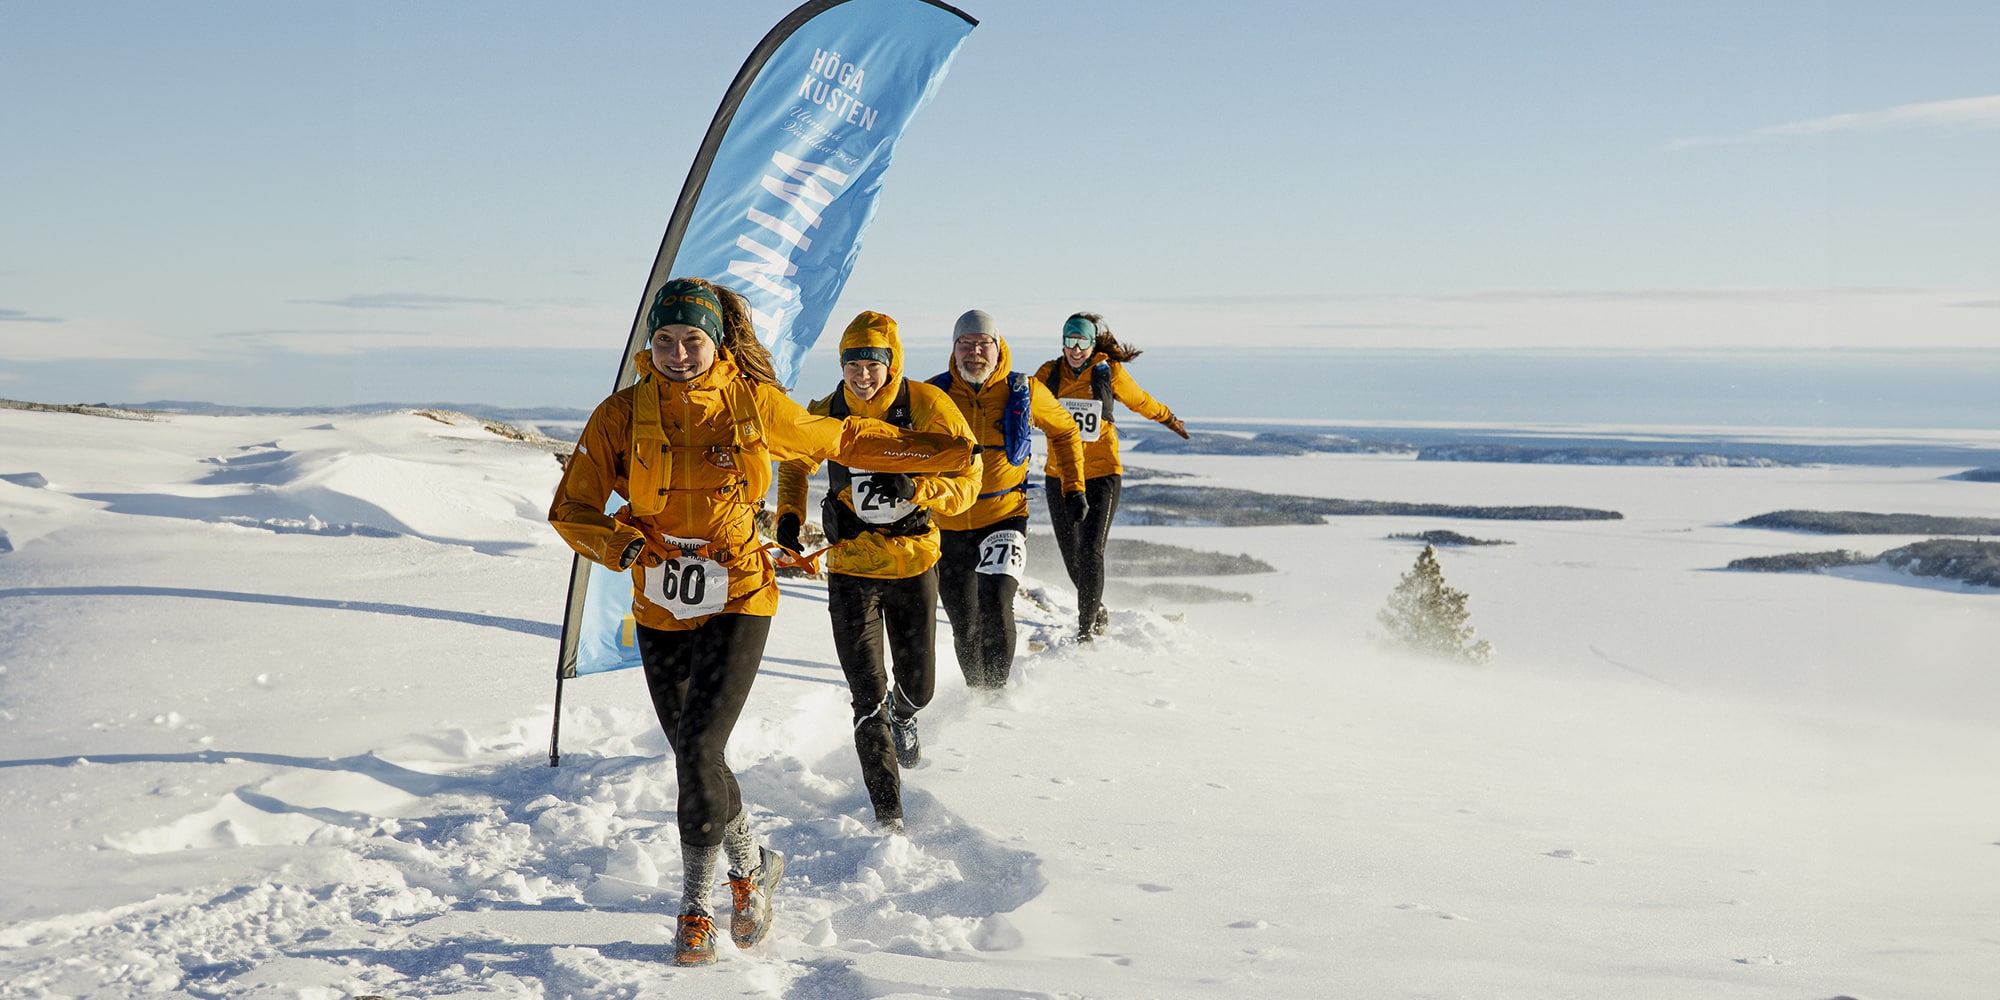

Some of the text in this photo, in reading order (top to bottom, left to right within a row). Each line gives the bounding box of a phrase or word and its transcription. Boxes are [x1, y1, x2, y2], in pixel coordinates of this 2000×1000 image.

[809, 47, 866, 95] HÖGA
[798, 73, 879, 132] KUSTEN
[979, 543, 1022, 568] 275
[663, 559, 706, 605] 60
